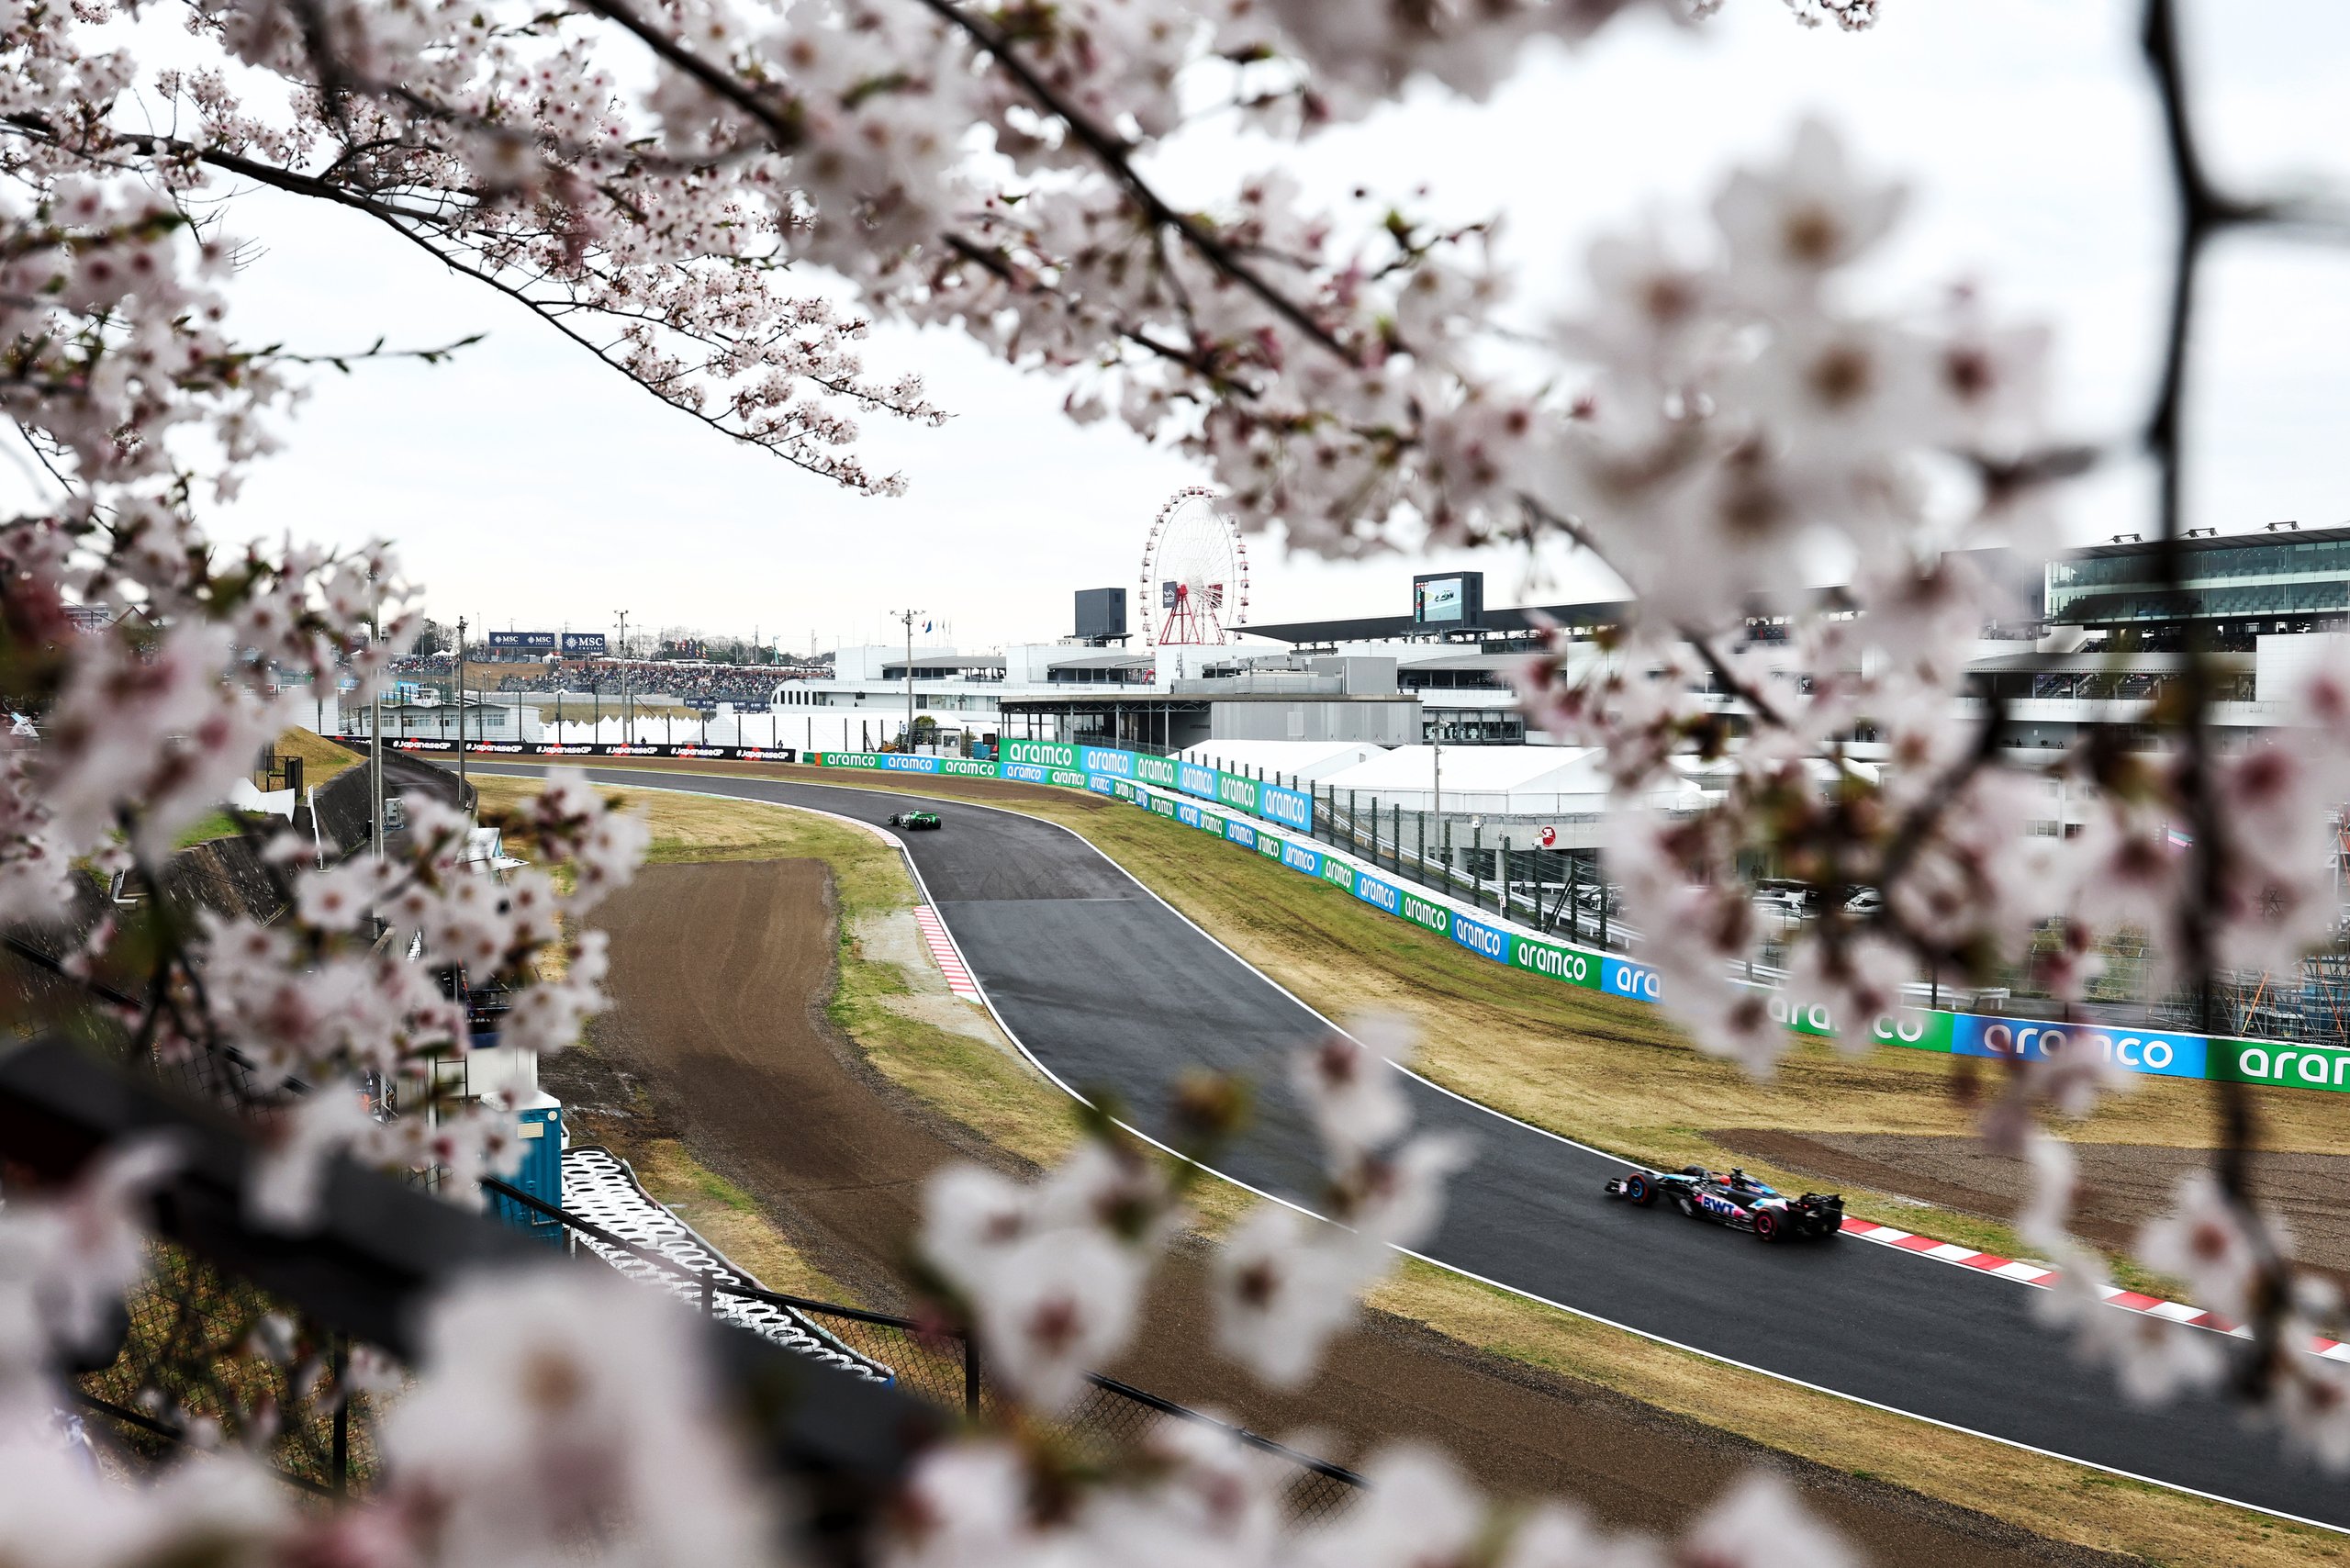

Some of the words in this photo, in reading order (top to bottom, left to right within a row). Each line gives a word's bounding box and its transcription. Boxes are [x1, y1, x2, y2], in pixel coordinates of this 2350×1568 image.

[578, 637, 603, 646] MSC
[901, 724, 907, 734] 5
[828, 754, 876, 767] aramco
[889, 756, 933, 770] aramco
[1011, 743, 1072, 766] aramco
[1088, 750, 1128, 774] aramco
[946, 761, 995, 775] aramco
[1007, 766, 1041, 780] aramco
[1052, 771, 1085, 786] aramco
[1138, 757, 1173, 783] aramco
[1182, 767, 1213, 795] aramco
[1221, 777, 1255, 808] aramco
[1265, 789, 1304, 824] aramco
[1201, 813, 1223, 834] aramco
[1229, 823, 1253, 846] aramco
[1286, 846, 1315, 871] aramco
[1326, 859, 1351, 889] aramco
[1360, 877, 1394, 909] aramco
[1404, 896, 1447, 931] aramco
[1457, 918, 1501, 957] aramco
[1518, 942, 1586, 981] aramco
[1617, 966, 1661, 998] ara
[1767, 995, 1923, 1042] araco
[1704, 1196, 1734, 1216] BWT
